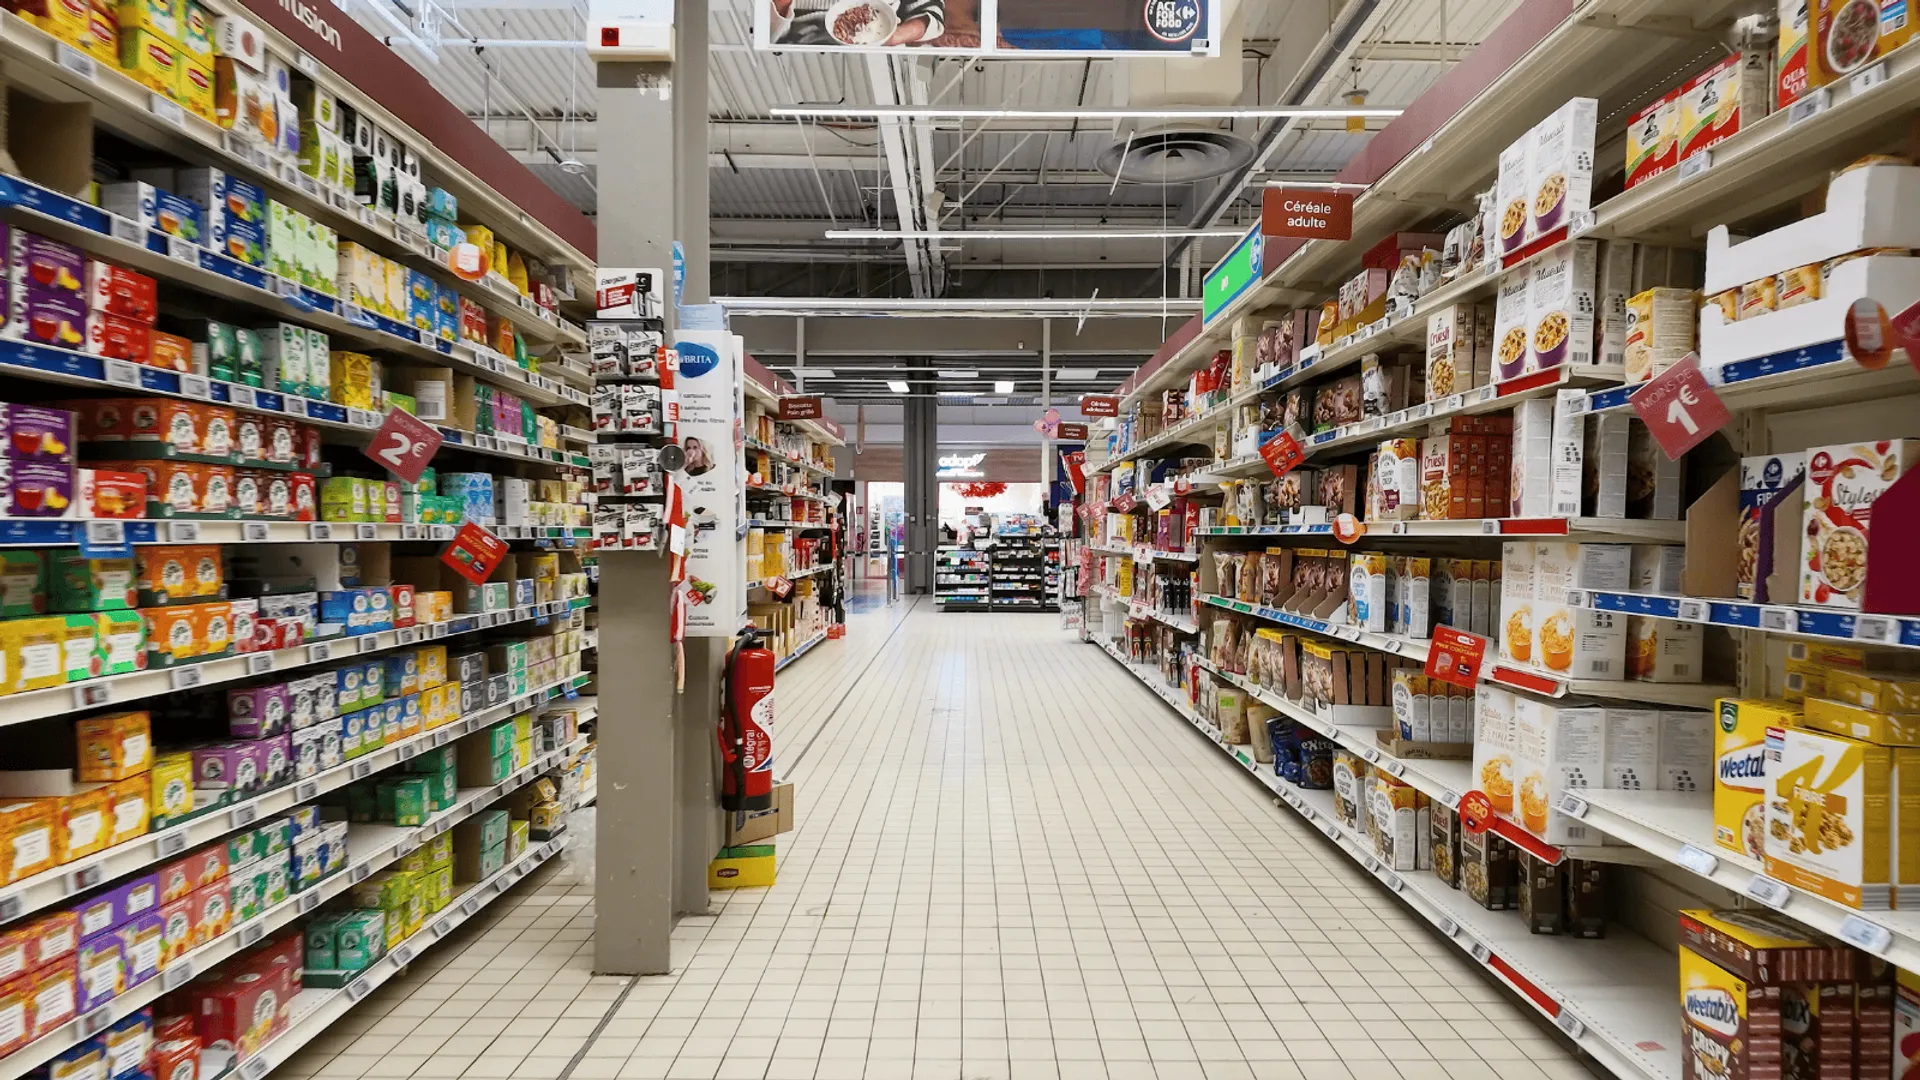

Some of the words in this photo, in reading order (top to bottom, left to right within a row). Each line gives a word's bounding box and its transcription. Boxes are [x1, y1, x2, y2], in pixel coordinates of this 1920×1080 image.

[1156, 11, 1175, 20] FOR
[1157, 2, 1175, 11] ACT
[279, 0, 342, 52] usion
[1156, 19, 1182, 28] FOOD
[1284, 200, 1331, 214] Céréale
[1287, 217, 1326, 228] adulte
[683, 355, 712, 364] BRITA
[1639, 380, 1677, 410] MOINS
[1676, 368, 1693, 384] DE
[1667, 384, 1700, 435] 1€
[392, 414, 423, 437] MOINS
[378, 432, 427, 466] 2€
[1466, 797, 1488, 818] 200
[1686, 993, 1737, 1026] Weetabix
